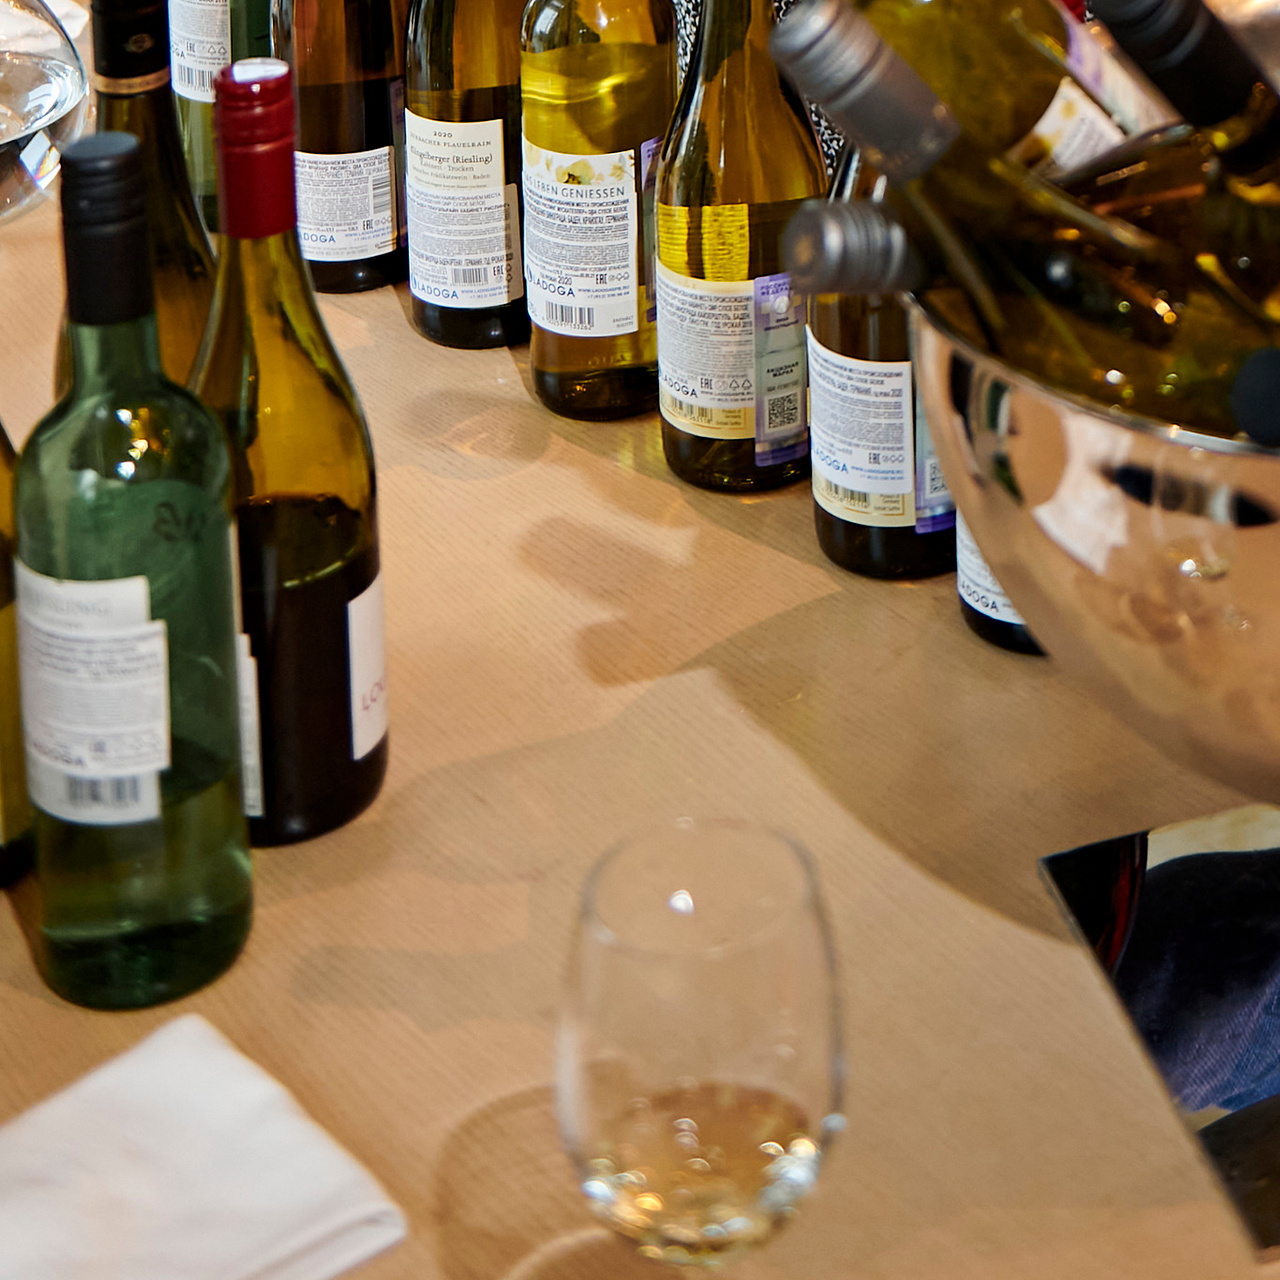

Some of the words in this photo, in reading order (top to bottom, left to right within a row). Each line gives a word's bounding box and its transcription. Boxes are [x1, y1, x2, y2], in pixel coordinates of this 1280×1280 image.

[433, 130, 453, 138] 2020
[443, 140, 492, 148] PLAUELRAIN
[452, 153, 493, 165] (Riesling)
[533, 180, 558, 196] LEBEN
[561, 186, 625, 200] GENIESSEN
[417, 279, 459, 299] LADOGA
[533, 279, 575, 298] LADOGA
